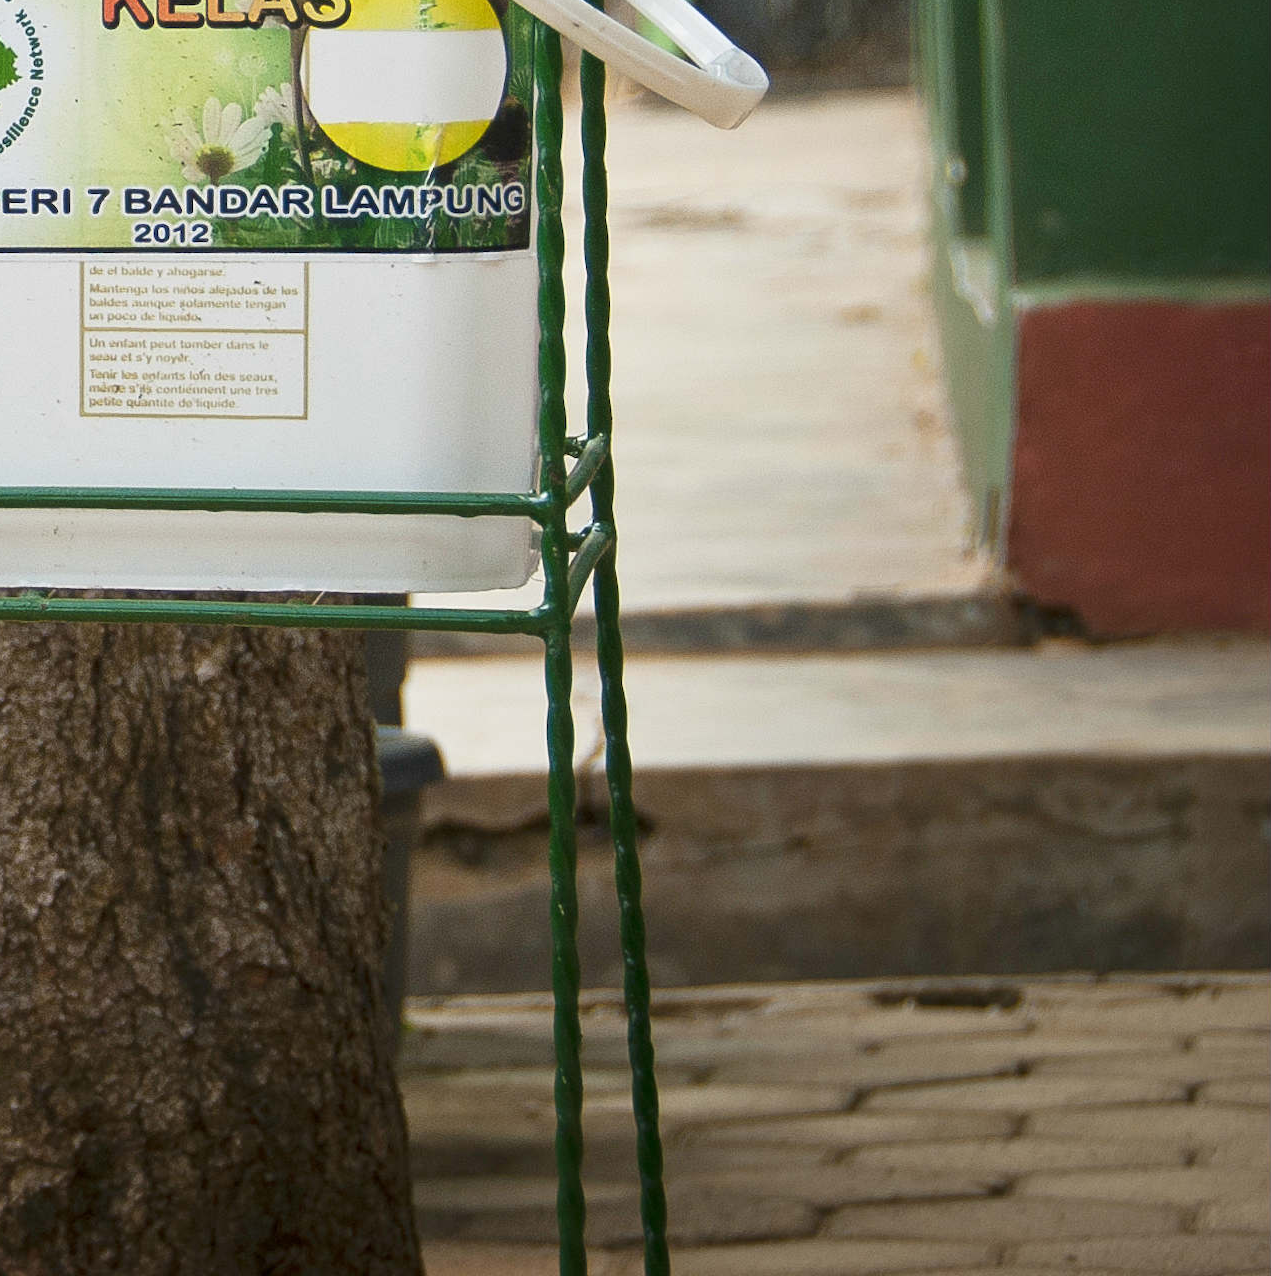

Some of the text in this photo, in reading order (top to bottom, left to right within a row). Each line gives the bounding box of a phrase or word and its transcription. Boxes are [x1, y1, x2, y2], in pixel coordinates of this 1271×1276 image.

[15, 8, 44, 81] Network
[86, 189, 111, 216] 7
[123, 186, 315, 218] BANDAR
[321, 183, 526, 217] LAMPUNG
[132, 222, 212, 245] 2012
[90, 266, 104, 275] de
[107, 266, 117, 275] el
[121, 266, 154, 276] balde
[157, 269, 163, 277] y
[89, 283, 148, 296] Mantenga
[152, 284, 169, 294] los
[209, 285, 259, 297] alejados
[262, 286, 277, 295] de
[281, 286, 299, 296] los
[89, 297, 286, 312] baldes aunque solamente tengan
[90, 313, 104, 321] un
[107, 312, 137, 322] poco
[140, 312, 155, 321] de
[89, 338, 270, 350] Un enfant peut tomber dans le
[89, 352, 117, 362] seau
[121, 352, 132, 362] et
[90, 368, 117, 379] Tenir
[121, 369, 138, 380] les
[142, 370, 186, 381] enfants
[189, 370, 211, 381] loin
[214, 371, 235, 381] des
[156, 385, 226, 395] contiennent
[230, 386, 252, 396] une
[89, 395, 123, 407] petite
[179, 398, 193, 408] de
